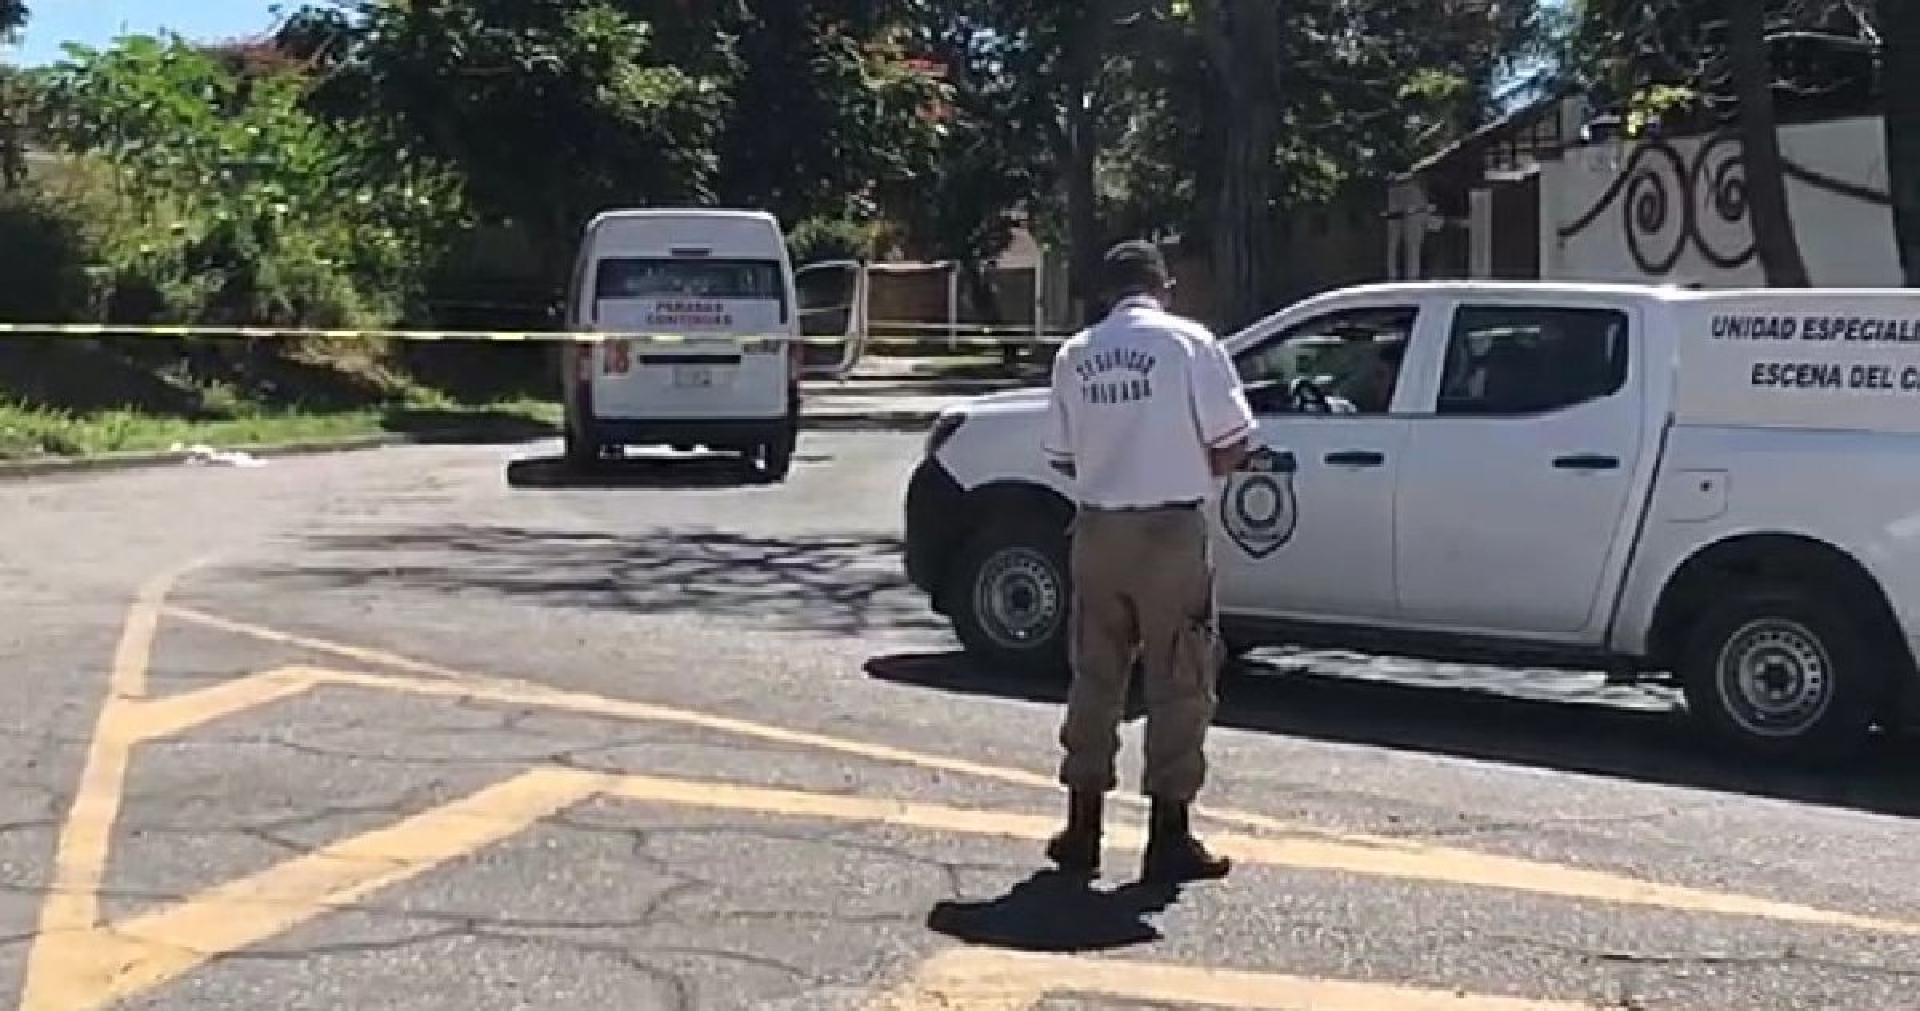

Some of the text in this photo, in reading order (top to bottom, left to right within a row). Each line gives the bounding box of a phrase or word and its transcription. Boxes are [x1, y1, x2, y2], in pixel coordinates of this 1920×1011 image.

[1711, 315, 1798, 340] UNIDAD
[1751, 362, 1920, 391] ESCENA DEL C
